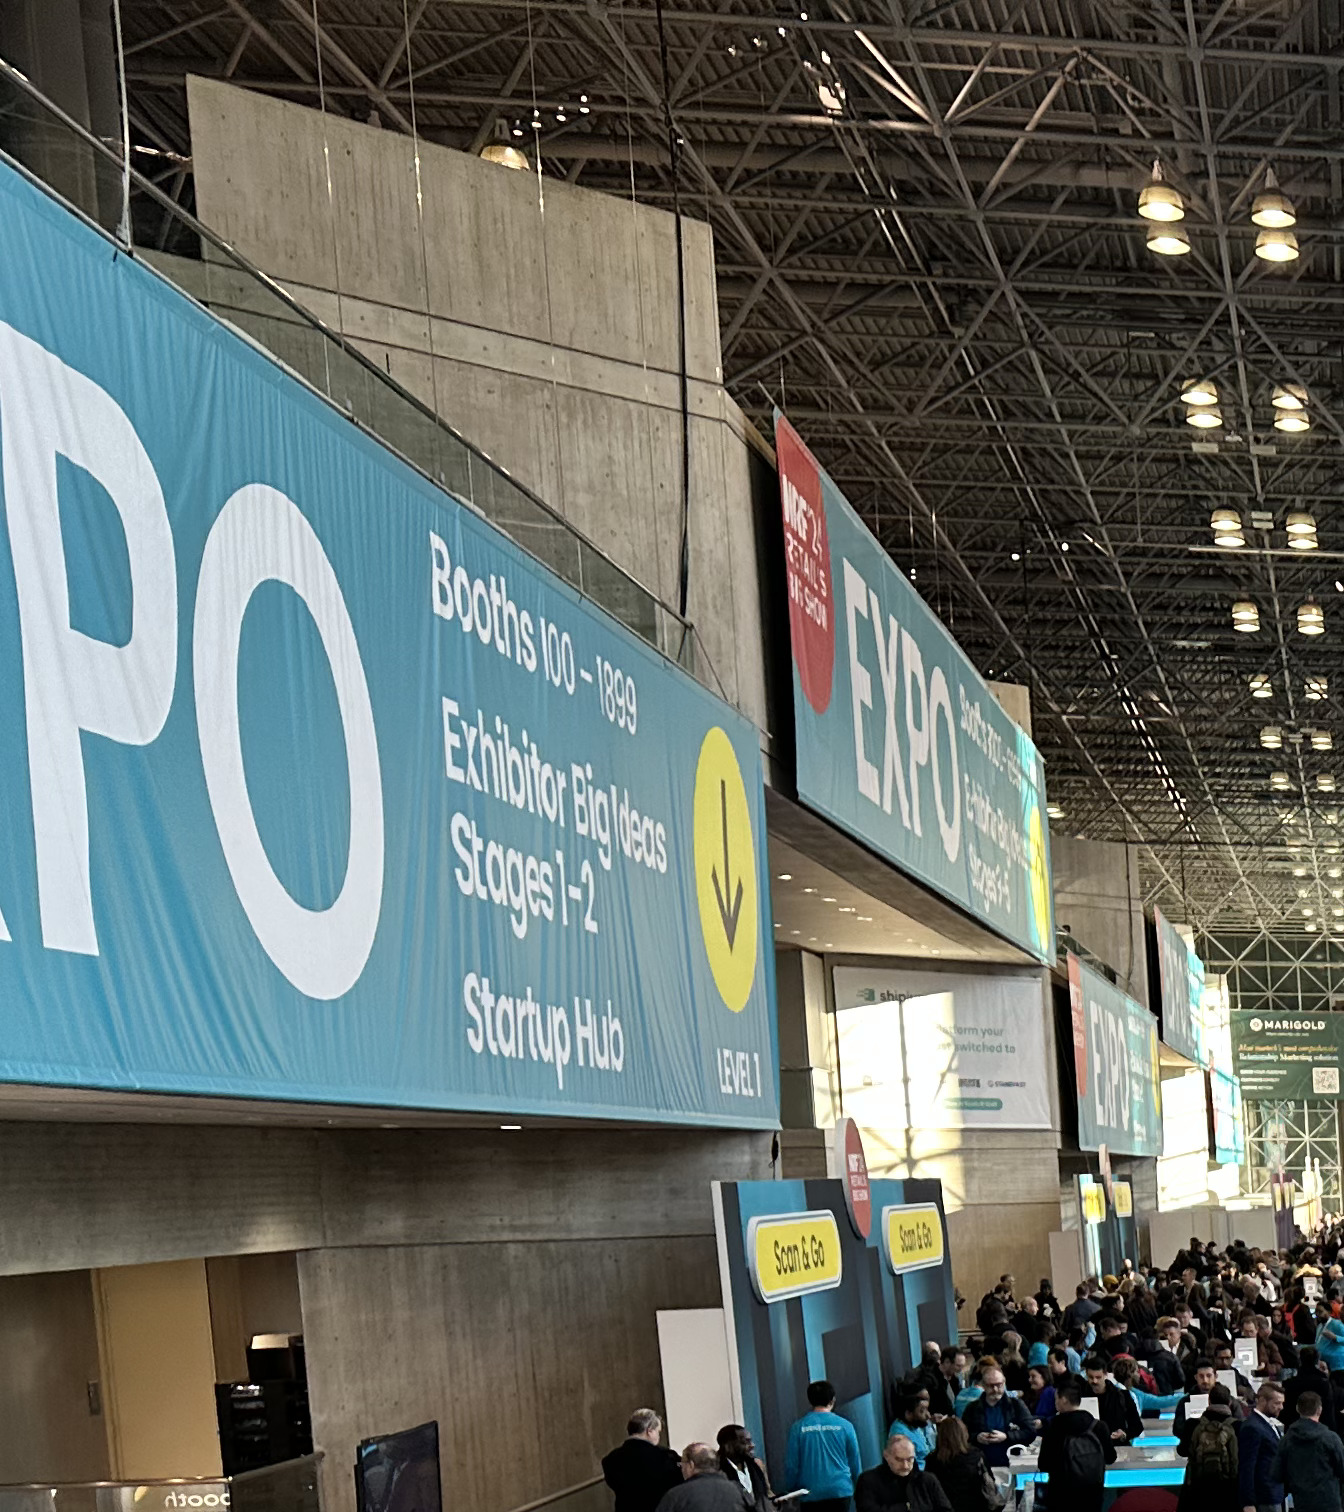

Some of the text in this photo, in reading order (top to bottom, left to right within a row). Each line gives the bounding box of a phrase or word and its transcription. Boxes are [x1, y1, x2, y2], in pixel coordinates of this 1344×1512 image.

[0, 320, 385, 1001] PO
[429, 530, 536, 674] Booths
[539, 615, 576, 697] 100
[595, 654, 639, 736] 1899
[843, 557, 961, 864] EXPO
[442, 696, 668, 874] Exhibitor Big Ideas
[451, 811, 555, 940] Stages
[463, 972, 625, 1090] Startup Hub
[717, 1047, 762, 1098] LEVEL 1
[980, 1027, 1004, 1038] your
[1005, 1043, 1016, 1054] to
[1089, 1000, 1130, 1131] EXPO
[1264, 1020, 1326, 1030] MARIGOLD
[773, 1234, 825, 1276] Scan & Go
[899, 1221, 933, 1254] Scan & Go
